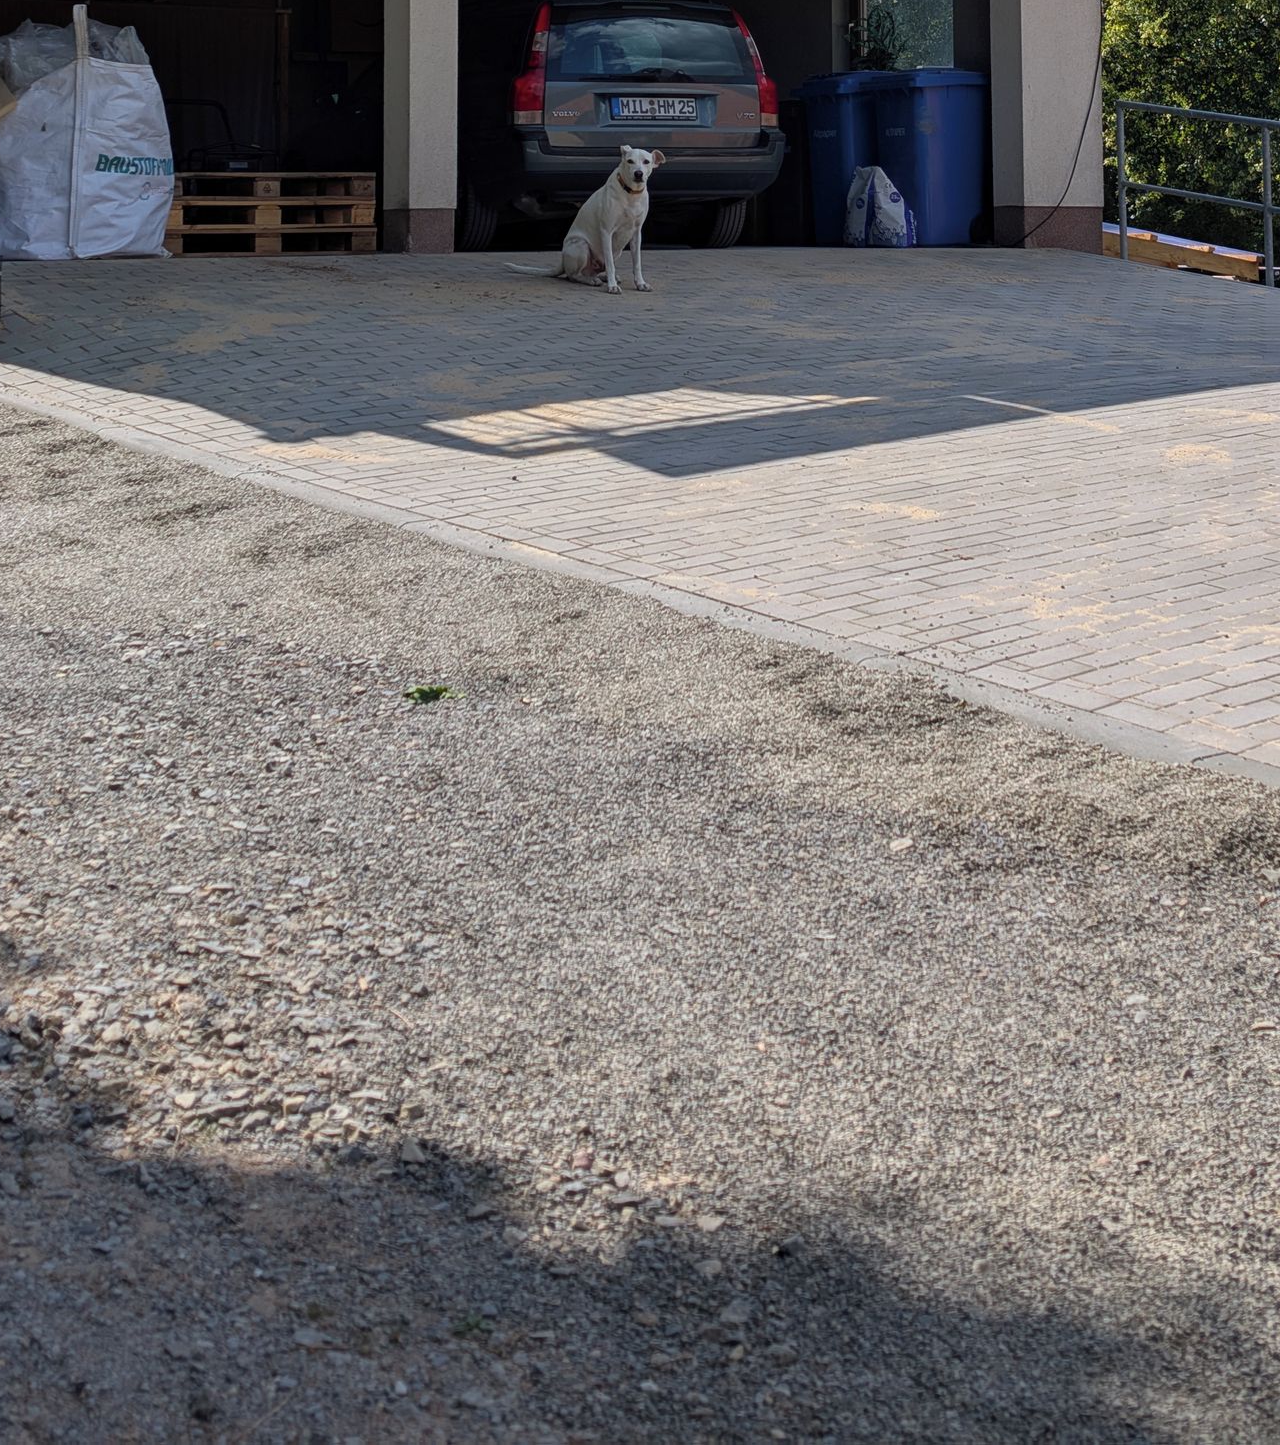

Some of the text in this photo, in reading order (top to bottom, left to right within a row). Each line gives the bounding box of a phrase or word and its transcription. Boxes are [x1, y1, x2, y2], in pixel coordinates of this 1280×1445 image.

[620, 99, 695, 115] MIL HM 25
